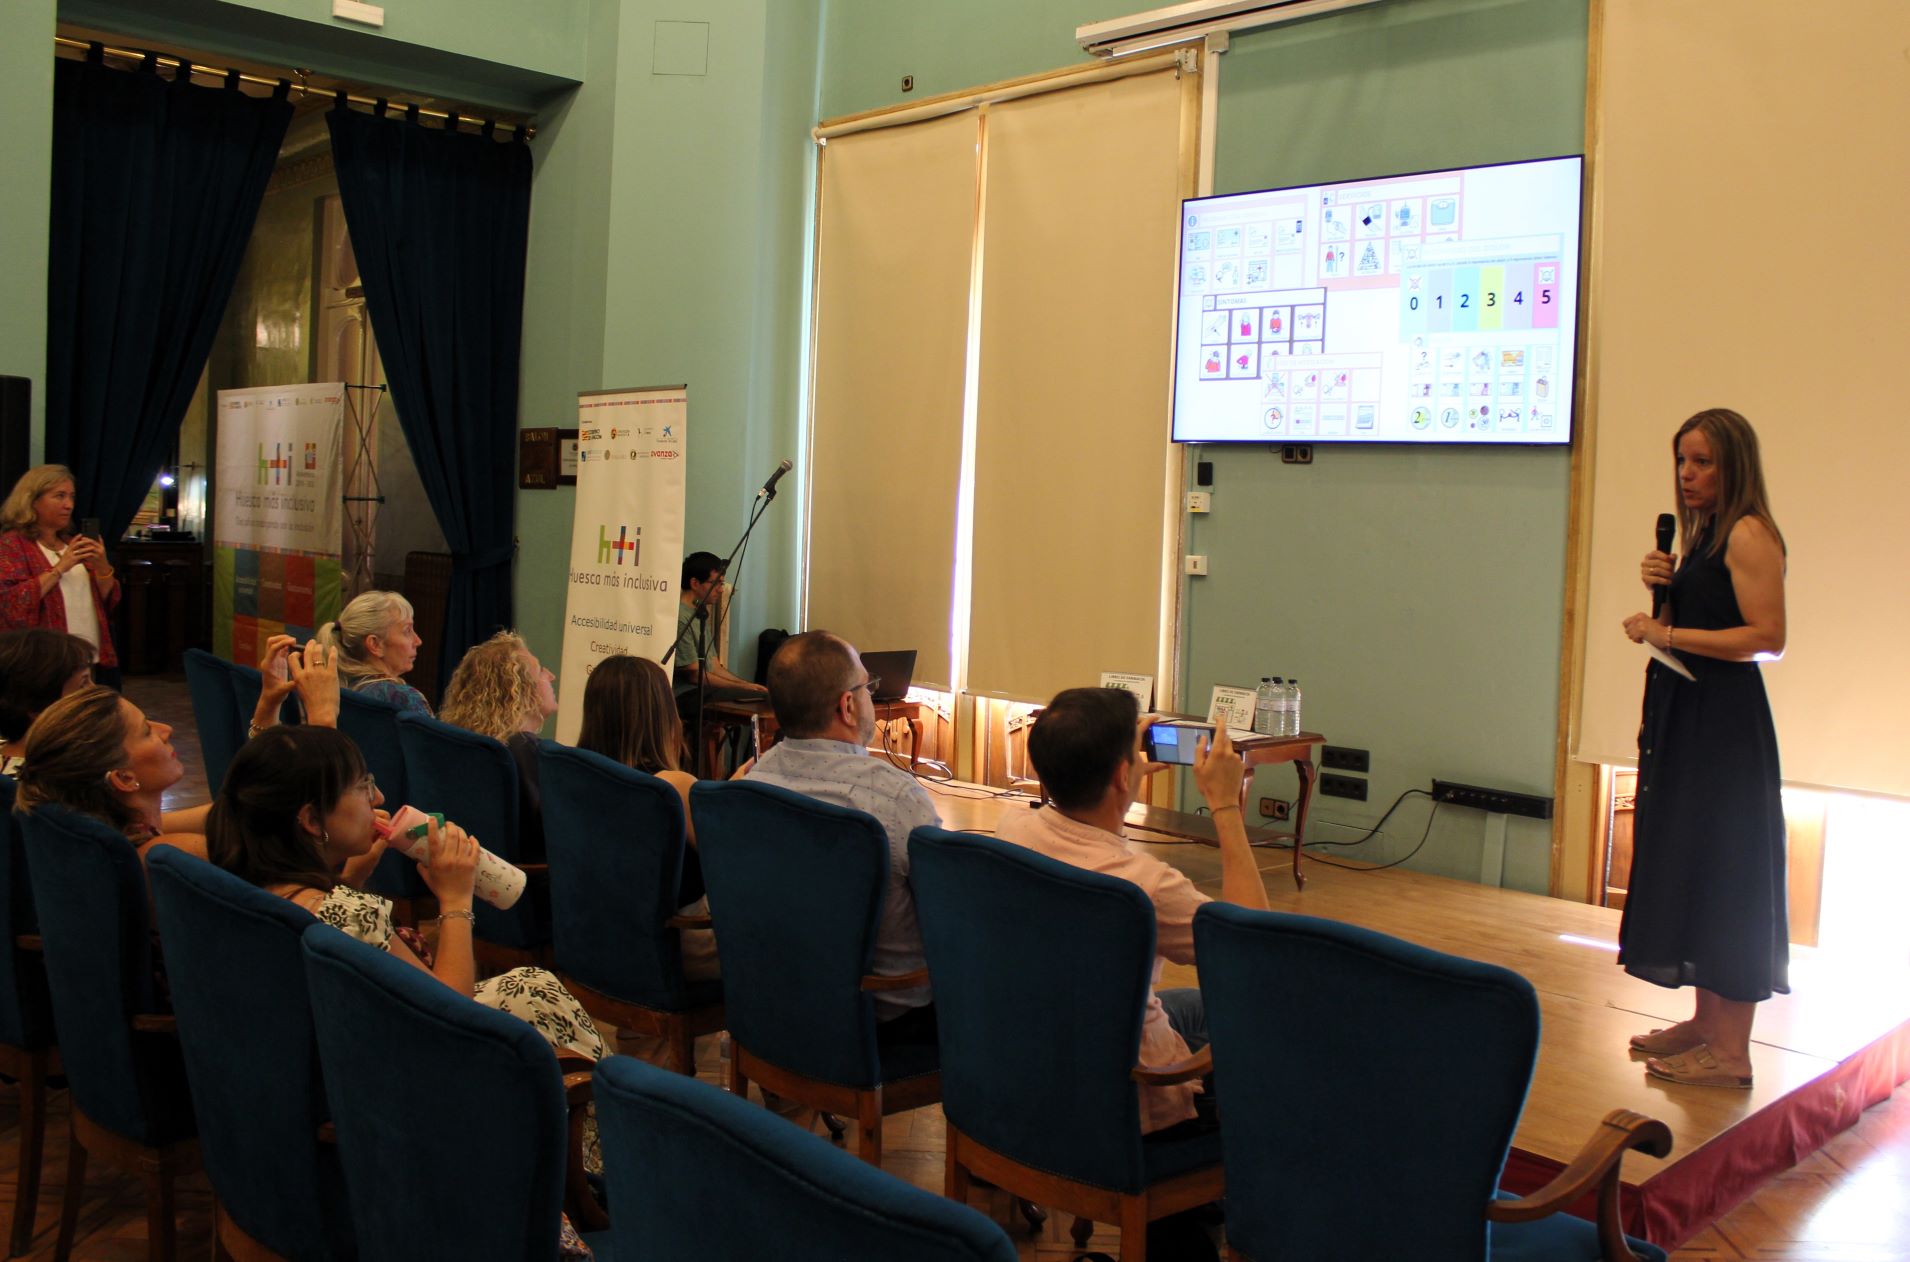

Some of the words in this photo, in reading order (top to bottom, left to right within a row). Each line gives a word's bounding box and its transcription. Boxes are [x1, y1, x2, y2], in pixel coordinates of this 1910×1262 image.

[1410, 297, 1418, 310] 0
[1436, 295, 1442, 309] 1
[1460, 294, 1469, 308] 2
[1487, 292, 1496, 307] 3
[1514, 291, 1523, 305] 4
[1541, 289, 1551, 304] 5
[569, 567, 601, 586] Huesca
[604, 571, 620, 588] más
[624, 573, 668, 592] inclusiva
[571, 615, 618, 631] Accesibilidad
[619, 621, 653, 636] universal
[591, 640, 629, 656] Creatividad
